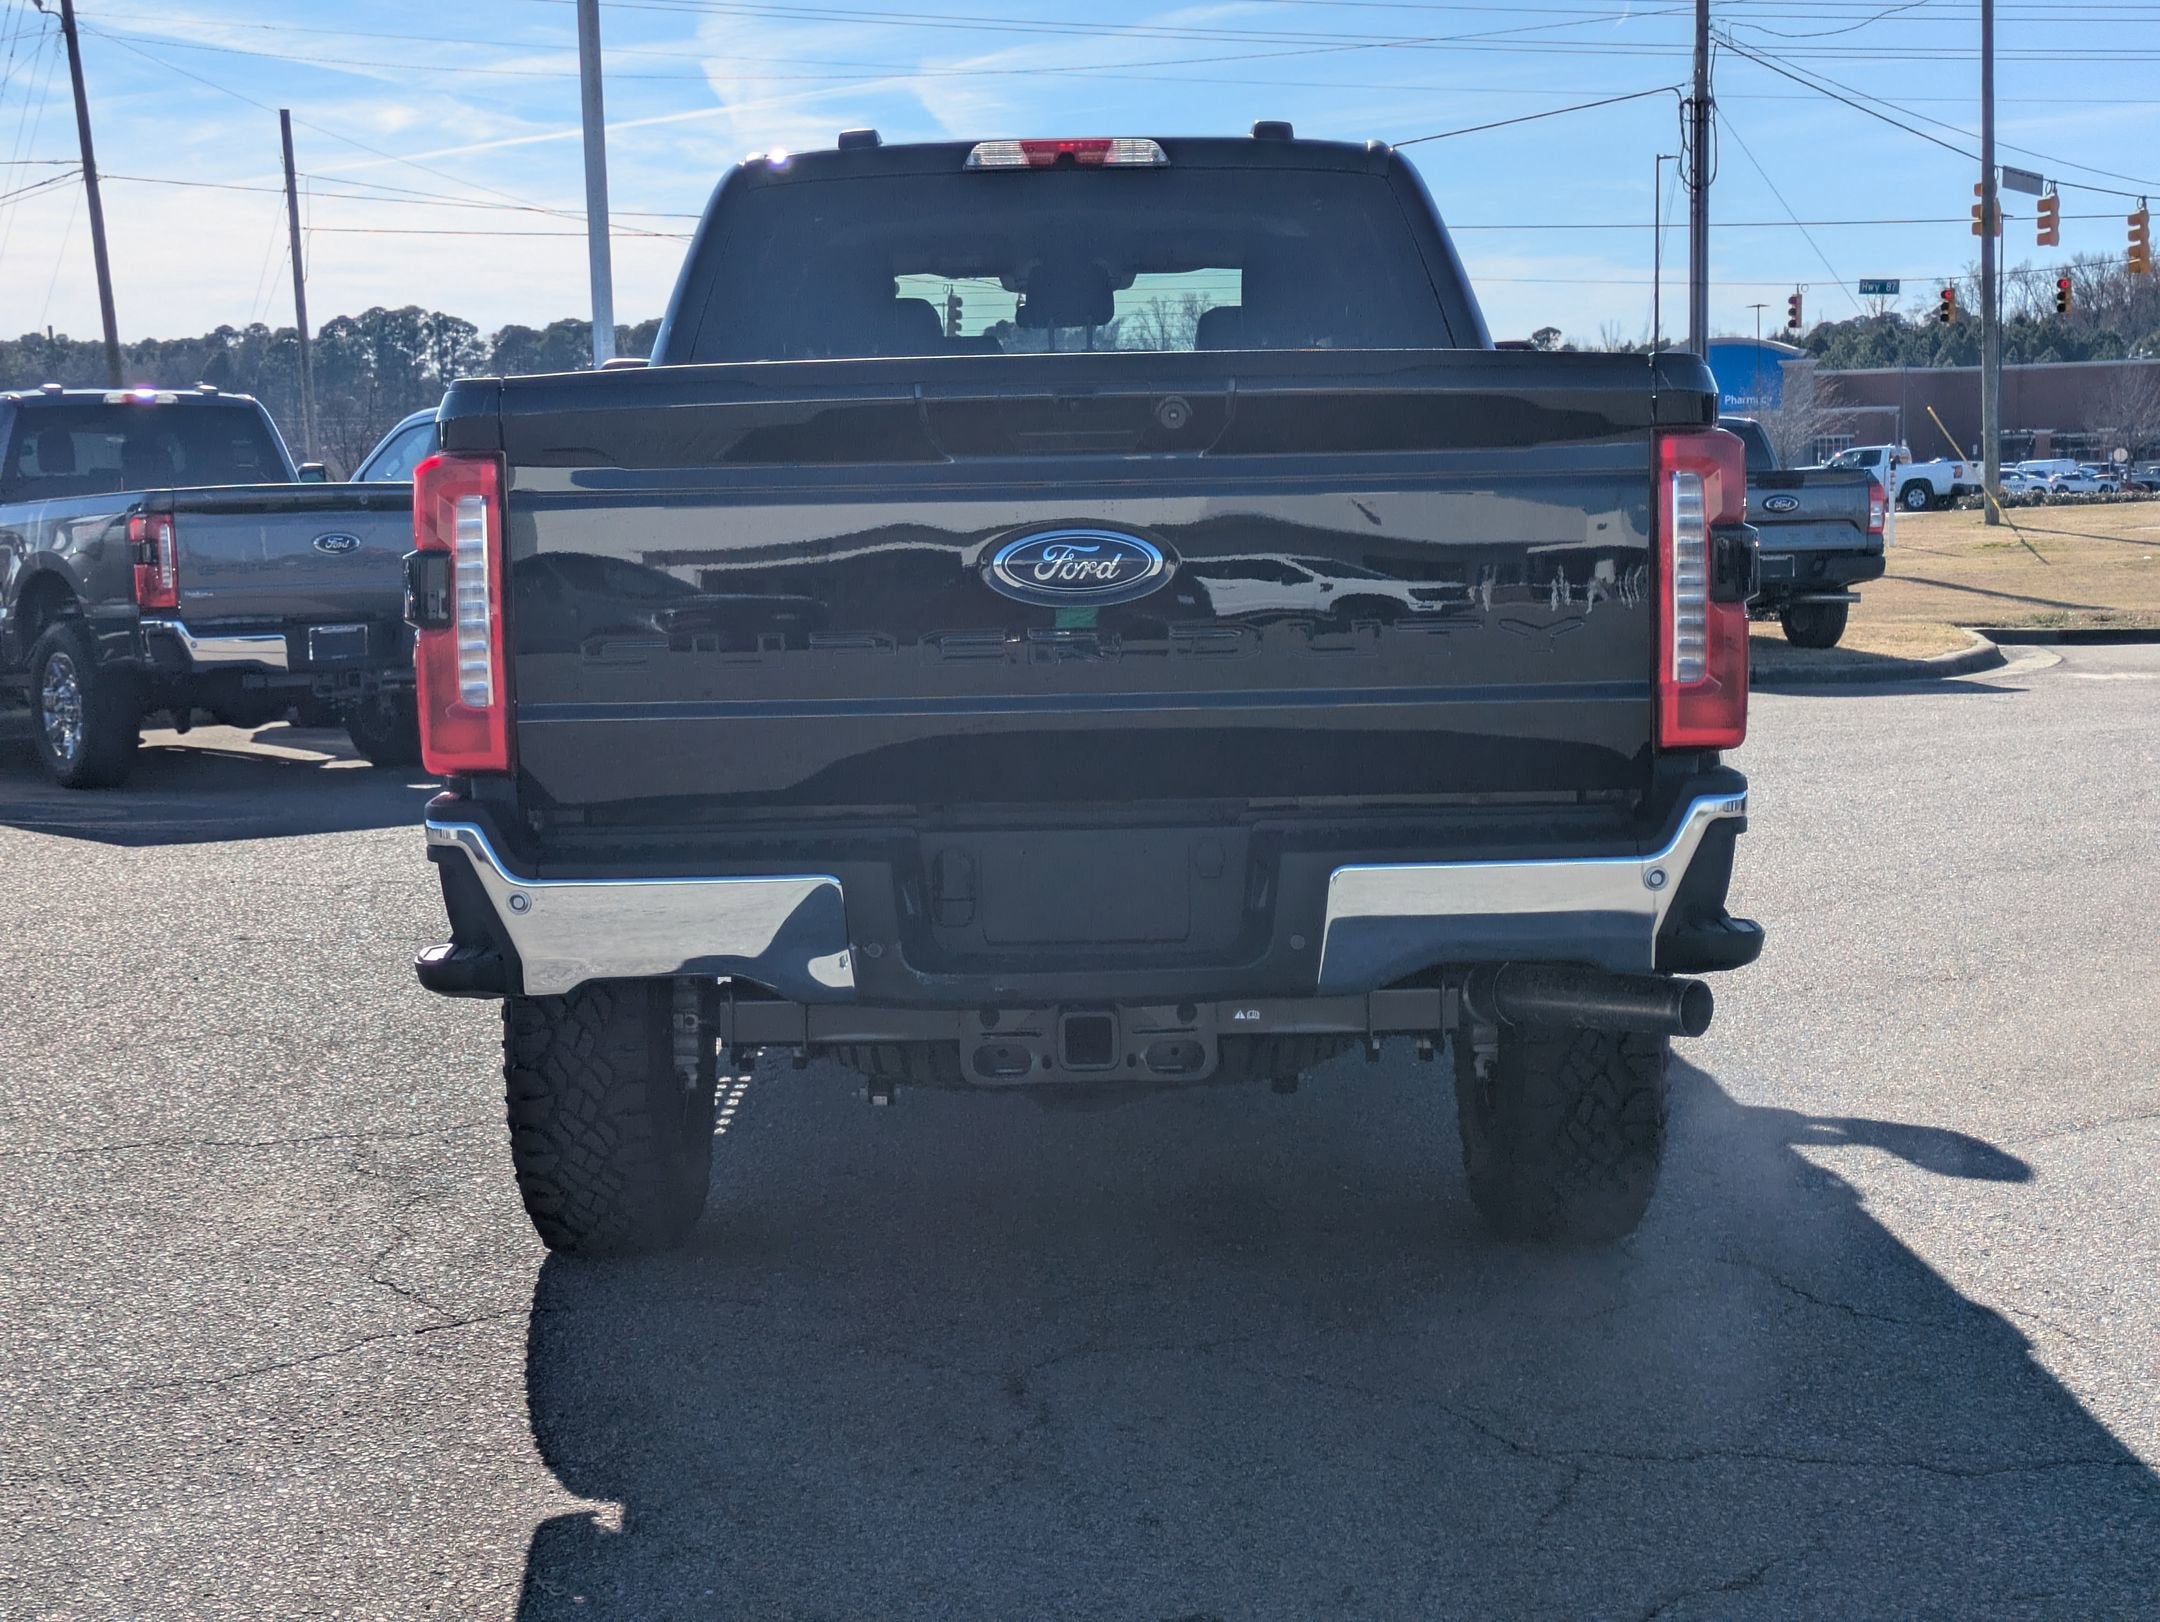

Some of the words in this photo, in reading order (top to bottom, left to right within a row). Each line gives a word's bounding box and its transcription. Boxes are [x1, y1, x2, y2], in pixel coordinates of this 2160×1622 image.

[1861, 281, 1881, 293] Hwy
[1885, 281, 1898, 292] 87
[325, 537, 350, 549] Ford
[1033, 544, 1123, 581] Ford
[580, 627, 1122, 672] SUPER
[1168, 614, 1586, 662] DUTY
